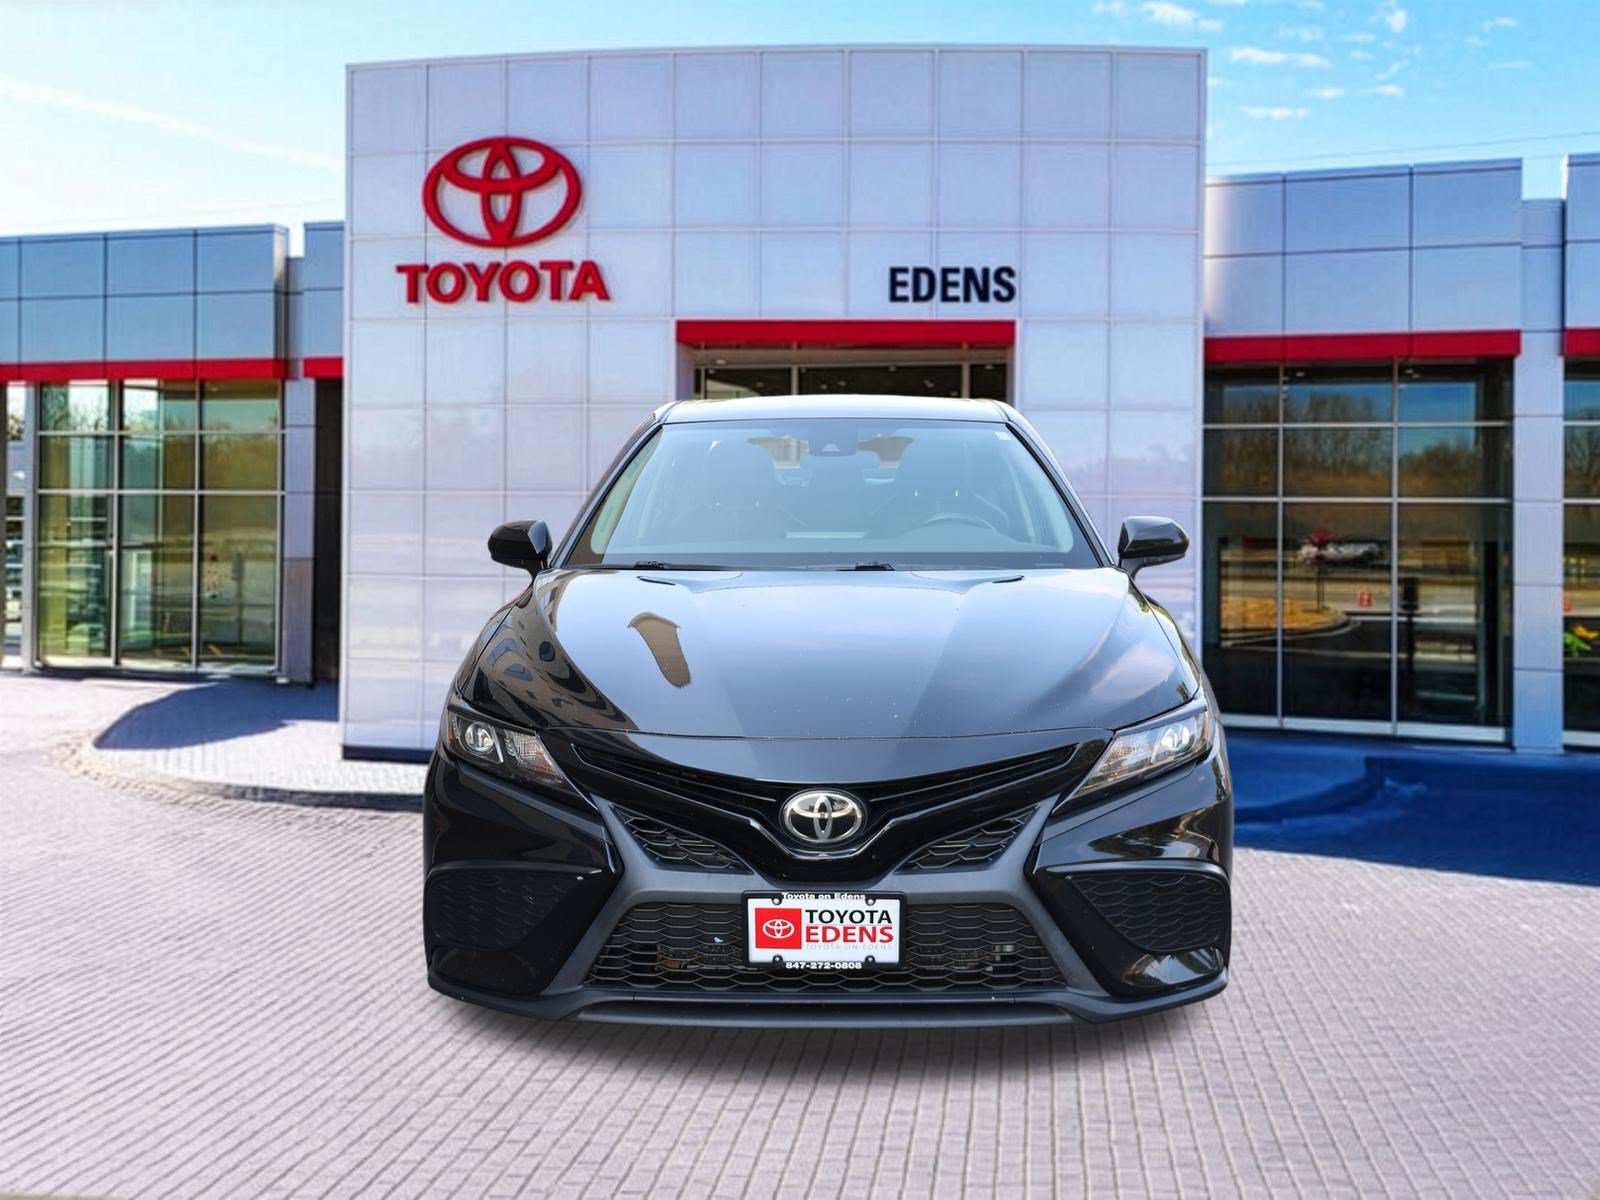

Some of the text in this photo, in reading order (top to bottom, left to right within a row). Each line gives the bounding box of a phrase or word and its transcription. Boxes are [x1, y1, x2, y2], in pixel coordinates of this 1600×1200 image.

[395, 260, 611, 303] TOYOTA
[889, 266, 1016, 303] EDENS
[782, 892, 815, 900] Toyota
[805, 909, 892, 923] TOYOTA
[805, 926, 894, 943] EDENS
